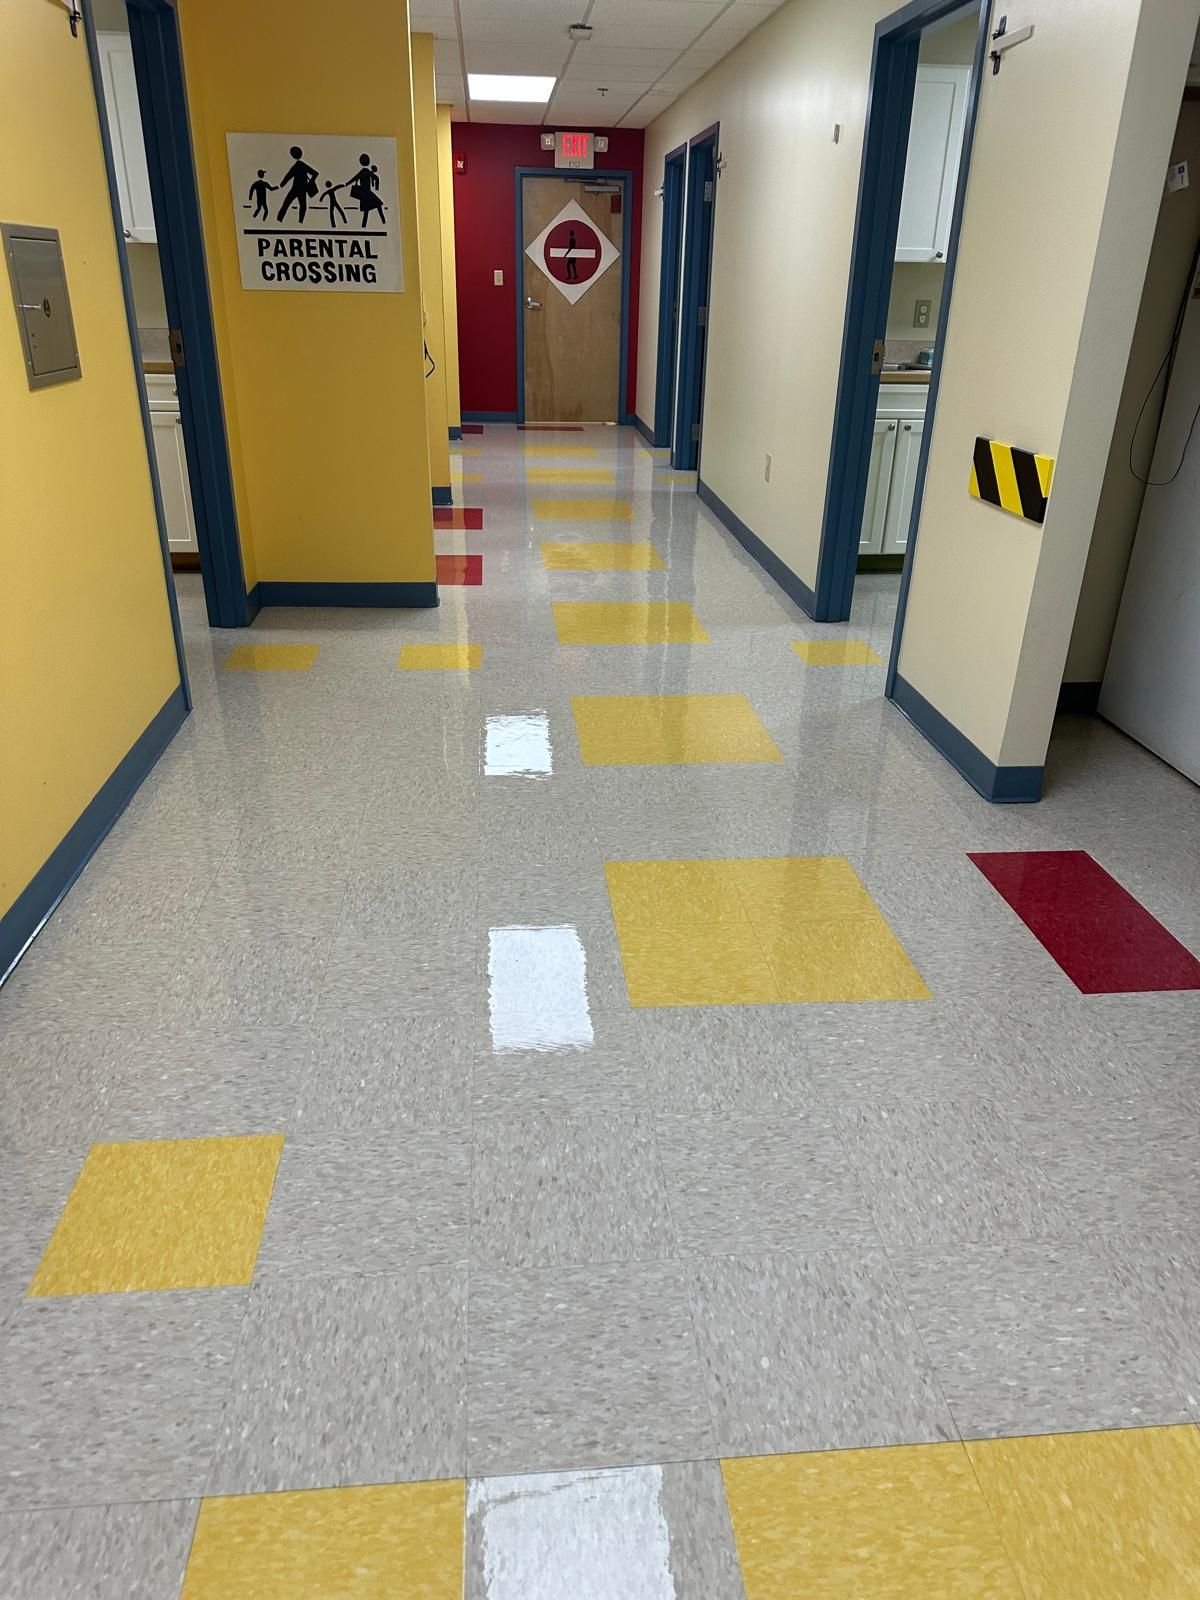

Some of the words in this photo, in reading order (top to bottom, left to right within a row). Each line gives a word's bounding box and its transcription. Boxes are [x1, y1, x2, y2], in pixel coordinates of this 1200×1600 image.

[562, 133, 589, 159] EXIT
[258, 238, 378, 259] PARENTAL
[261, 261, 377, 284] CROSSING
